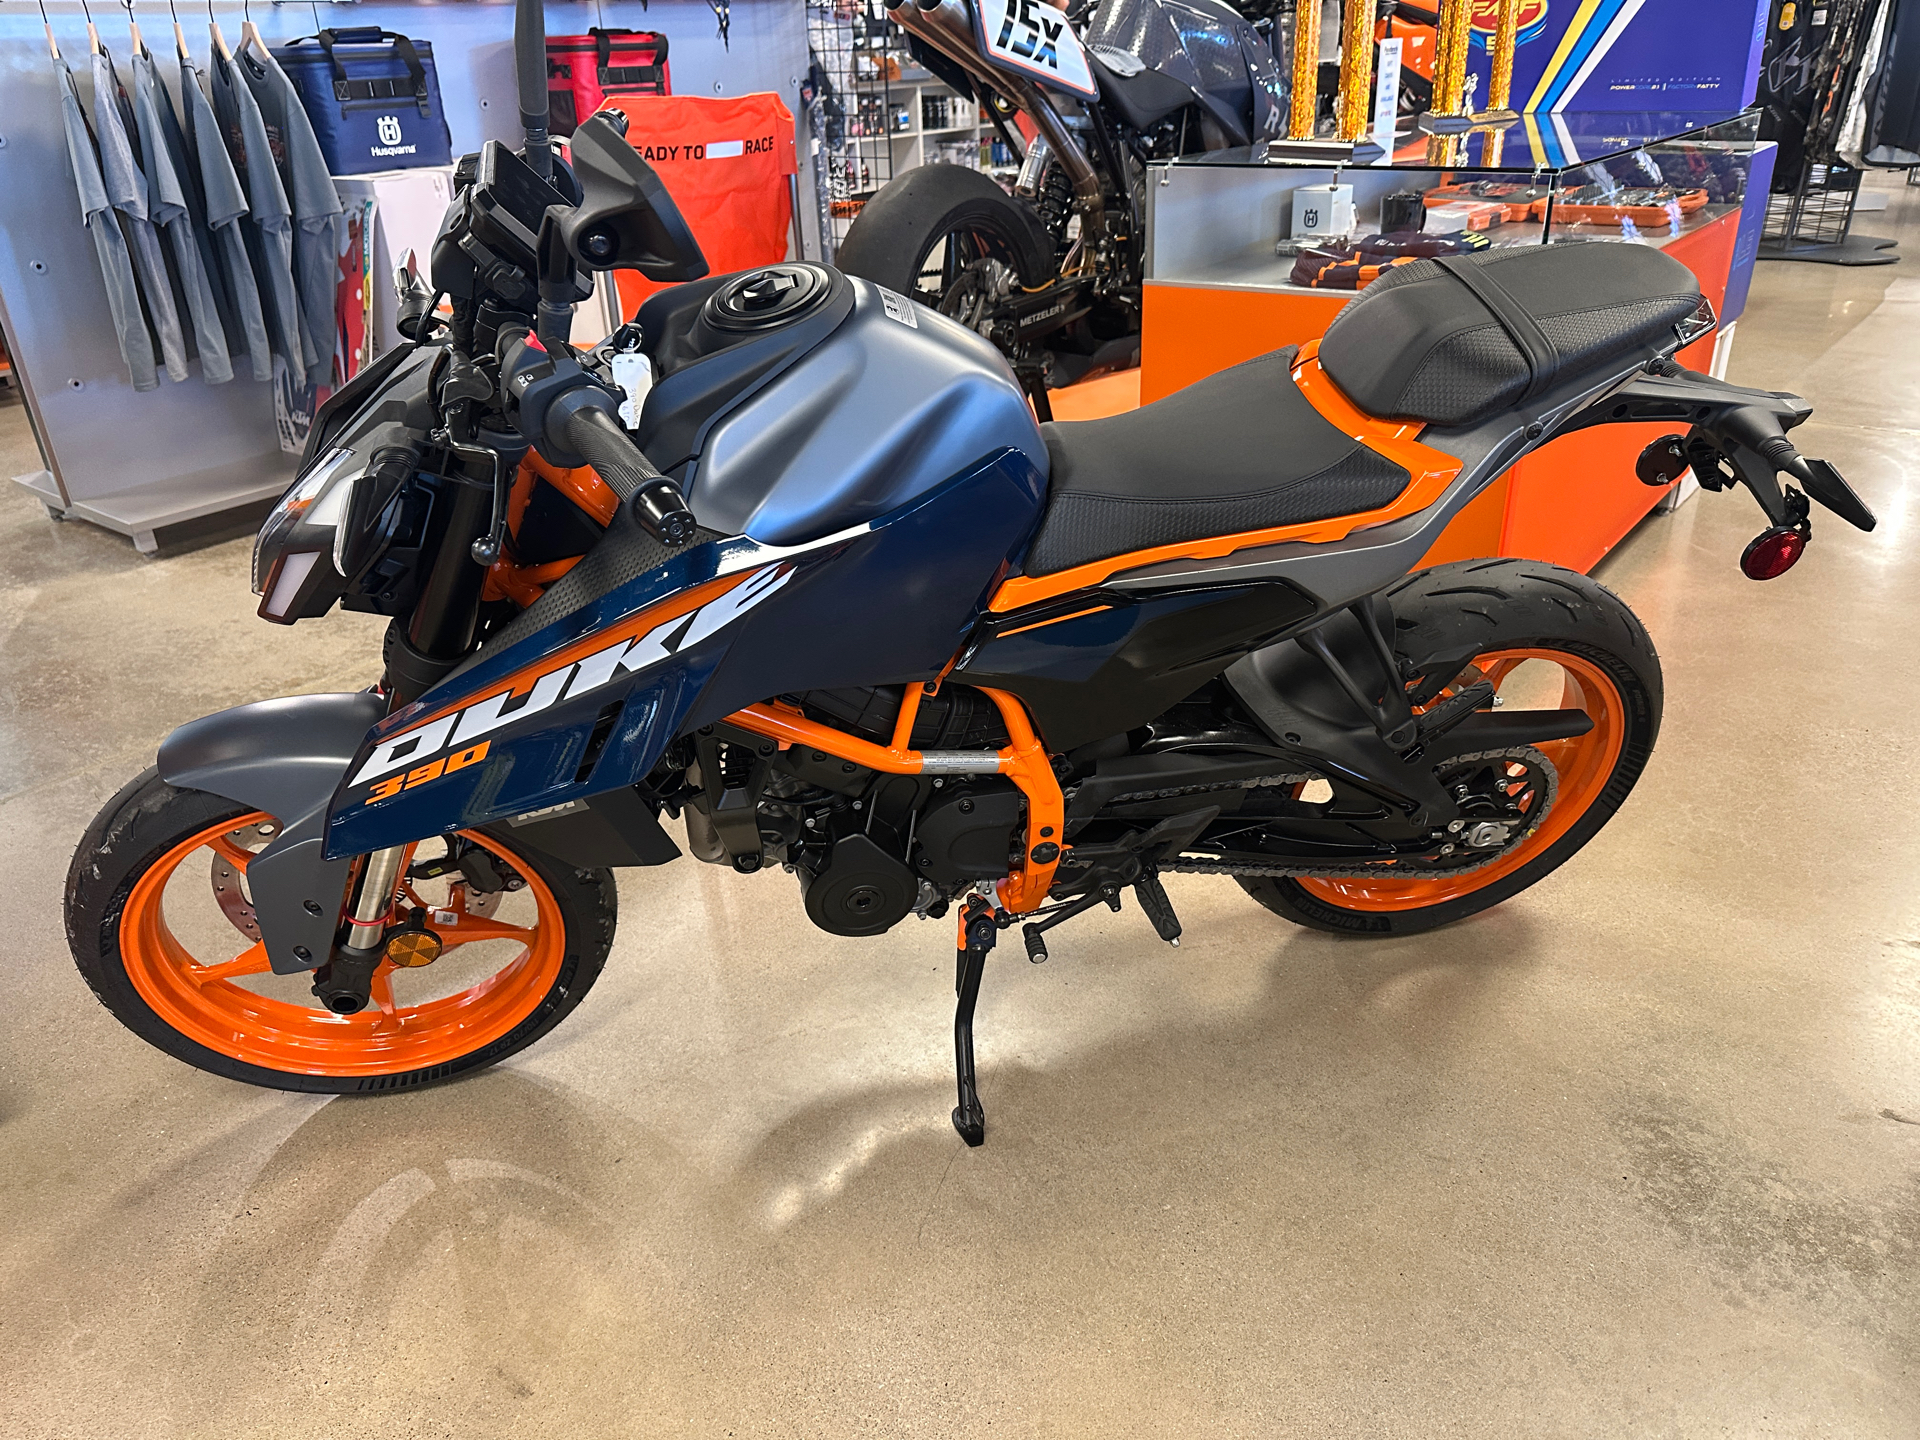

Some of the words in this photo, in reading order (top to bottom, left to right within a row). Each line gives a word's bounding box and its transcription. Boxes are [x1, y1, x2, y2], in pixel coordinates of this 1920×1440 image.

[370, 144, 417, 157] Husqvarna
[683, 145, 704, 160] TO
[744, 136, 774, 155] RACE
[1020, 304, 1060, 328] METZELER
[291, 409, 311, 427] KTM
[347, 560, 799, 789] DUKE
[364, 739, 492, 806] 390
[1295, 898, 1363, 930] MICHELIN
